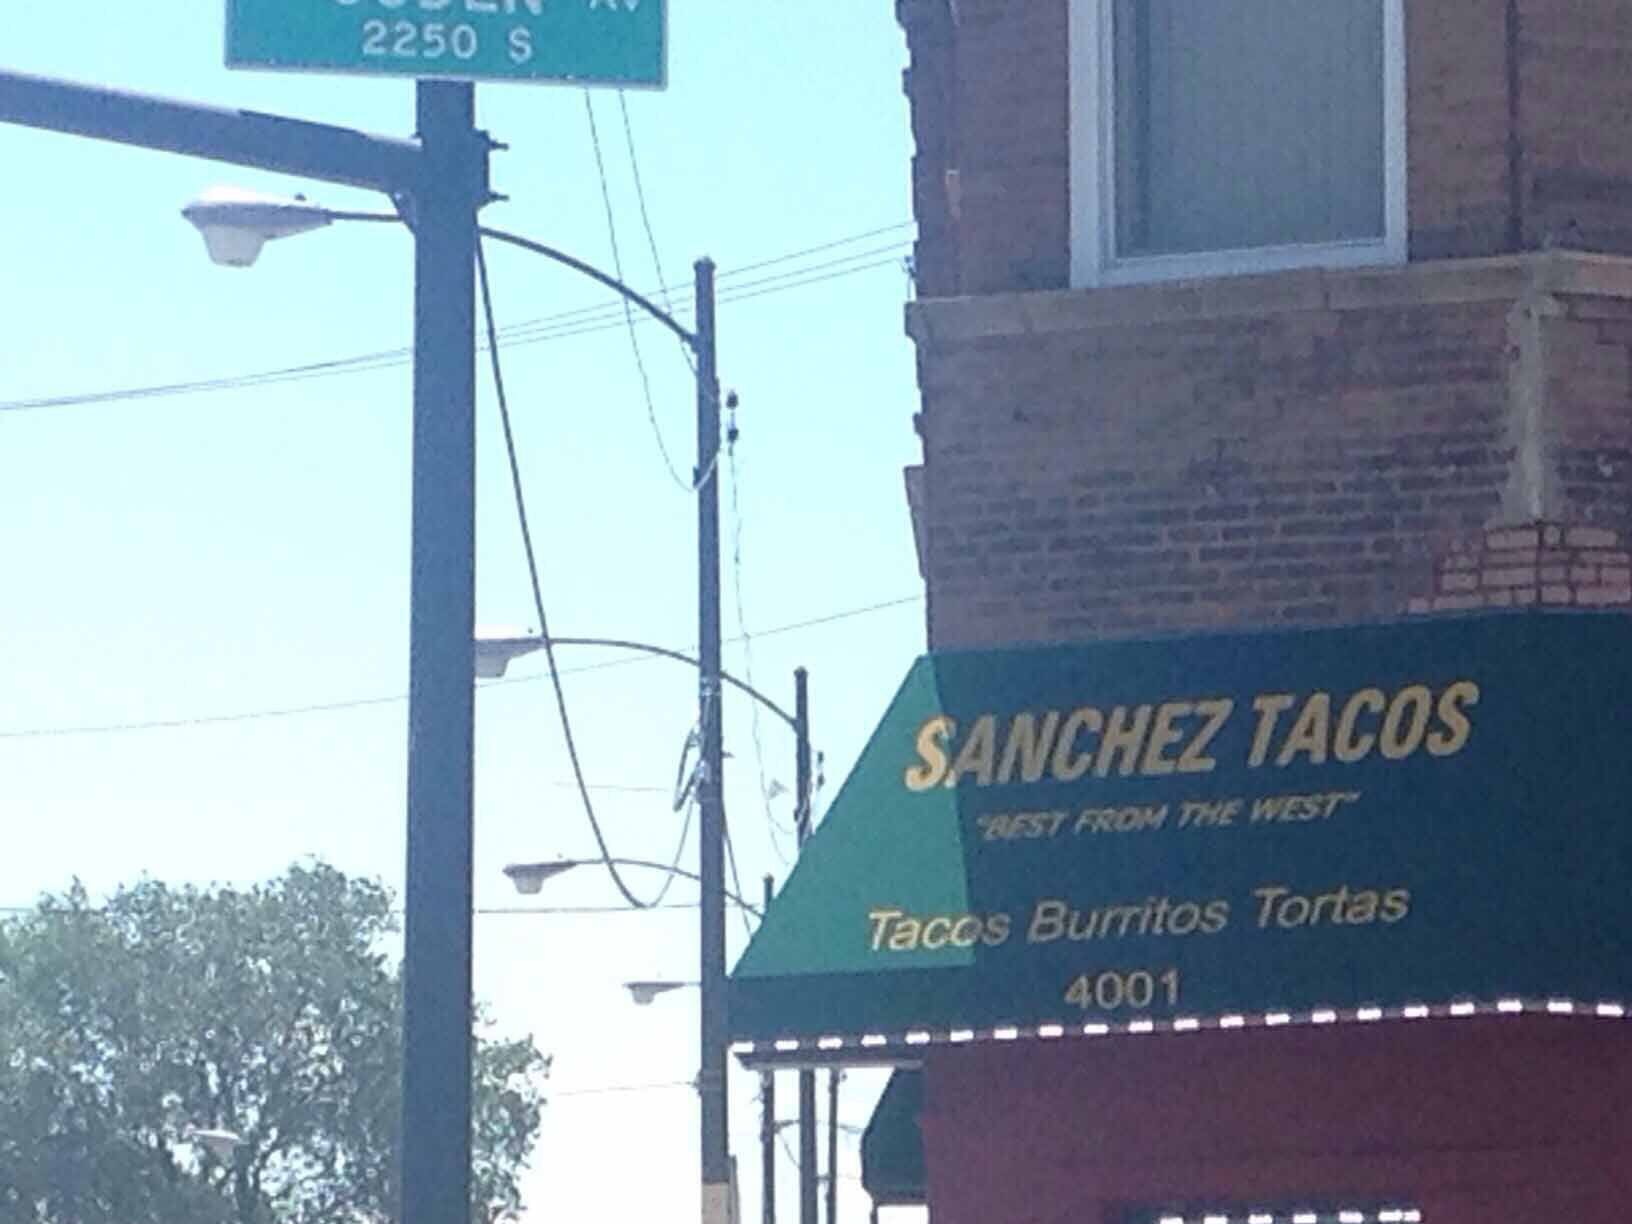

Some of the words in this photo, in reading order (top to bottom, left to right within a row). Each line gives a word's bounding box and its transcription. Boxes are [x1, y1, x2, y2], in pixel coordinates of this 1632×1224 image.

[361, 18, 478, 60] 2250
[508, 25, 533, 64] S
[904, 698, 1234, 791] SANCHEZ
[1248, 680, 1481, 769] TACOS
[1074, 804, 1169, 834] FROM
[1178, 798, 1245, 828] THE
[868, 908, 1012, 951] Tacos
[1026, 897, 1231, 944] Burritos
[1255, 884, 1411, 929] Tortas
[1064, 969, 1181, 1009] 4001
